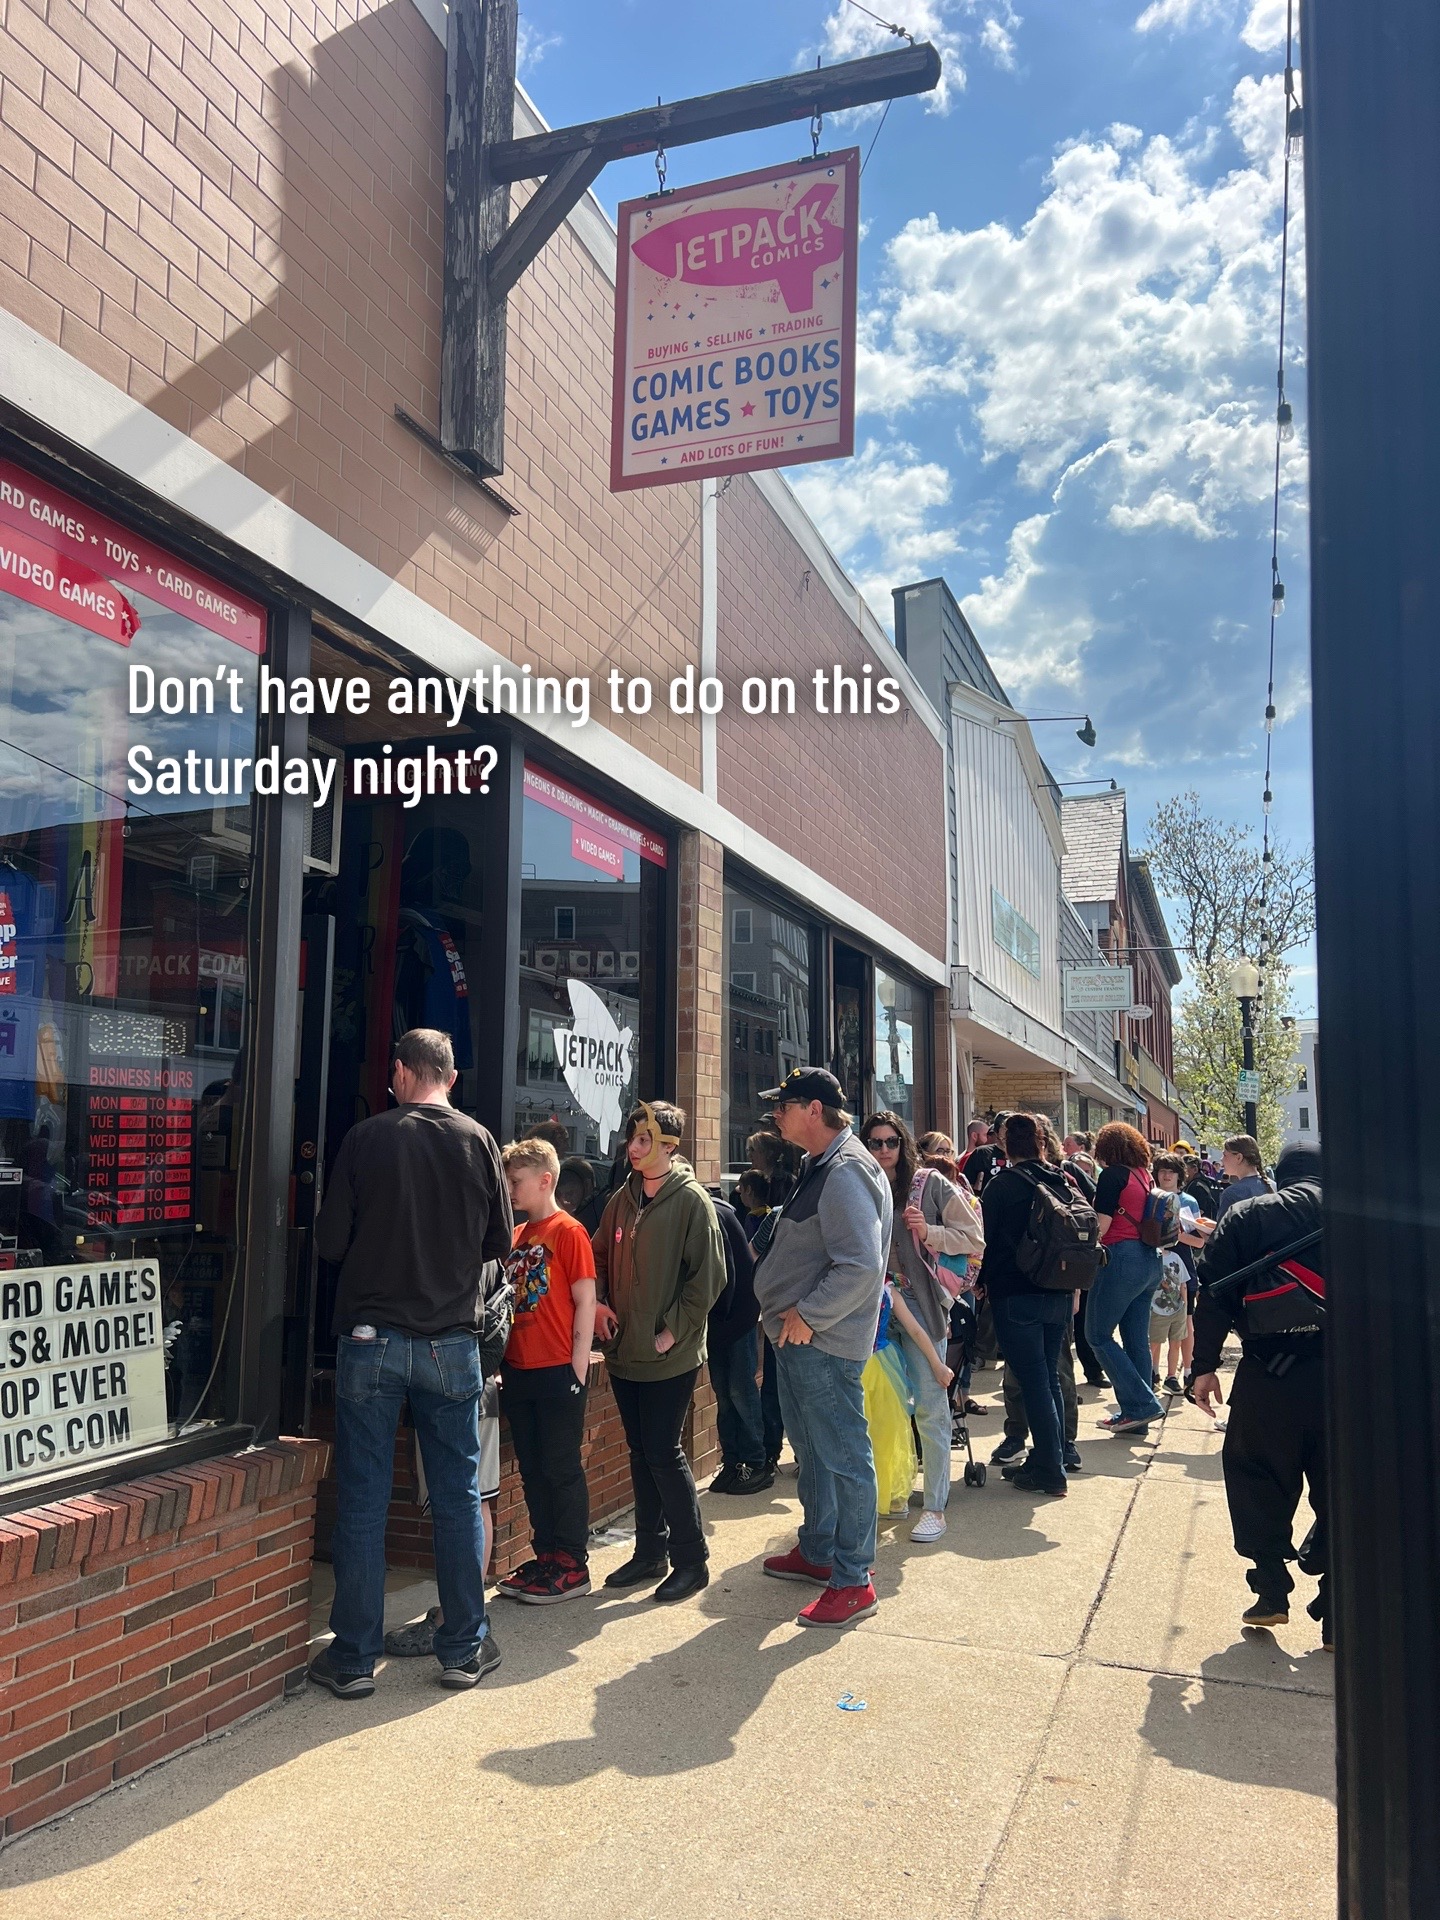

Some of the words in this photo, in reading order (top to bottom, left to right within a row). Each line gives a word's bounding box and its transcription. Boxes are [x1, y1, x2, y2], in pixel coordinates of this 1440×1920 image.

[673, 201, 825, 281] JETPACK
[751, 237, 825, 269] COMICS
[648, 341, 689, 359] BUYING
[707, 329, 753, 347] SELLING
[771, 315, 823, 335] TRADING
[633, 361, 724, 404] COMIC
[735, 340, 840, 386] BOOKS
[632, 398, 730, 441] GAMES
[765, 379, 840, 419] TOYS
[681, 450, 704, 464] AND
[708, 445, 735, 460] LOTS
[738, 442, 752, 454] OF
[756, 436, 784, 451] FUN!
[1, 481, 25, 509] RD
[29, 499, 85, 543] GAMES
[104, 538, 139, 572] TOYS
[157, 569, 193, 600] CARD
[196, 590, 238, 625] GAMES
[0, 546, 54, 590] VIDEO
[59, 578, 115, 620] GAMES
[551, 787, 556, 798] &
[557, 789, 583, 812] DRAGONS
[588, 806, 604, 824] MAGIC
[608, 818, 629, 837] GRAPHIC
[630, 830, 646, 847] NOVELS
[650, 841, 663, 856] CARDS
[580, 838, 597, 856] VIDEO
[598, 847, 615, 865] GAMES
[562, 1034, 624, 1072] JETPACK
[90, 1067, 151, 1088] BUSINESS
[154, 1069, 193, 1088] HOURS
[595, 1072, 623, 1087] COMICS
[1240, 1071, 1246, 1081] 2
[90, 1096, 118, 1110] MON
[149, 1097, 164, 1110] TO
[90, 1115, 114, 1128] TUE
[149, 1115, 164, 1128] TO
[90, 1135, 116, 1148] WED
[149, 1134, 164, 1147] TO
[89, 1153, 115, 1167] THU
[148, 1152, 163, 1165] TO
[88, 1173, 109, 1187] FRI
[148, 1170, 163, 1183] TO
[88, 1192, 112, 1206] SAT
[148, 1189, 162, 1202] TO
[87, 1211, 112, 1226] SUN
[147, 1207, 162, 1221] TO
[3, 1280, 43, 1320] RD
[55, 1267, 156, 1312] GAMES
[62, 1312, 155, 1359] MORE!
[1, 1377, 40, 1419] OP
[53, 1361, 127, 1410] EVER
[4, 1407, 130, 1471] ICS.COM
